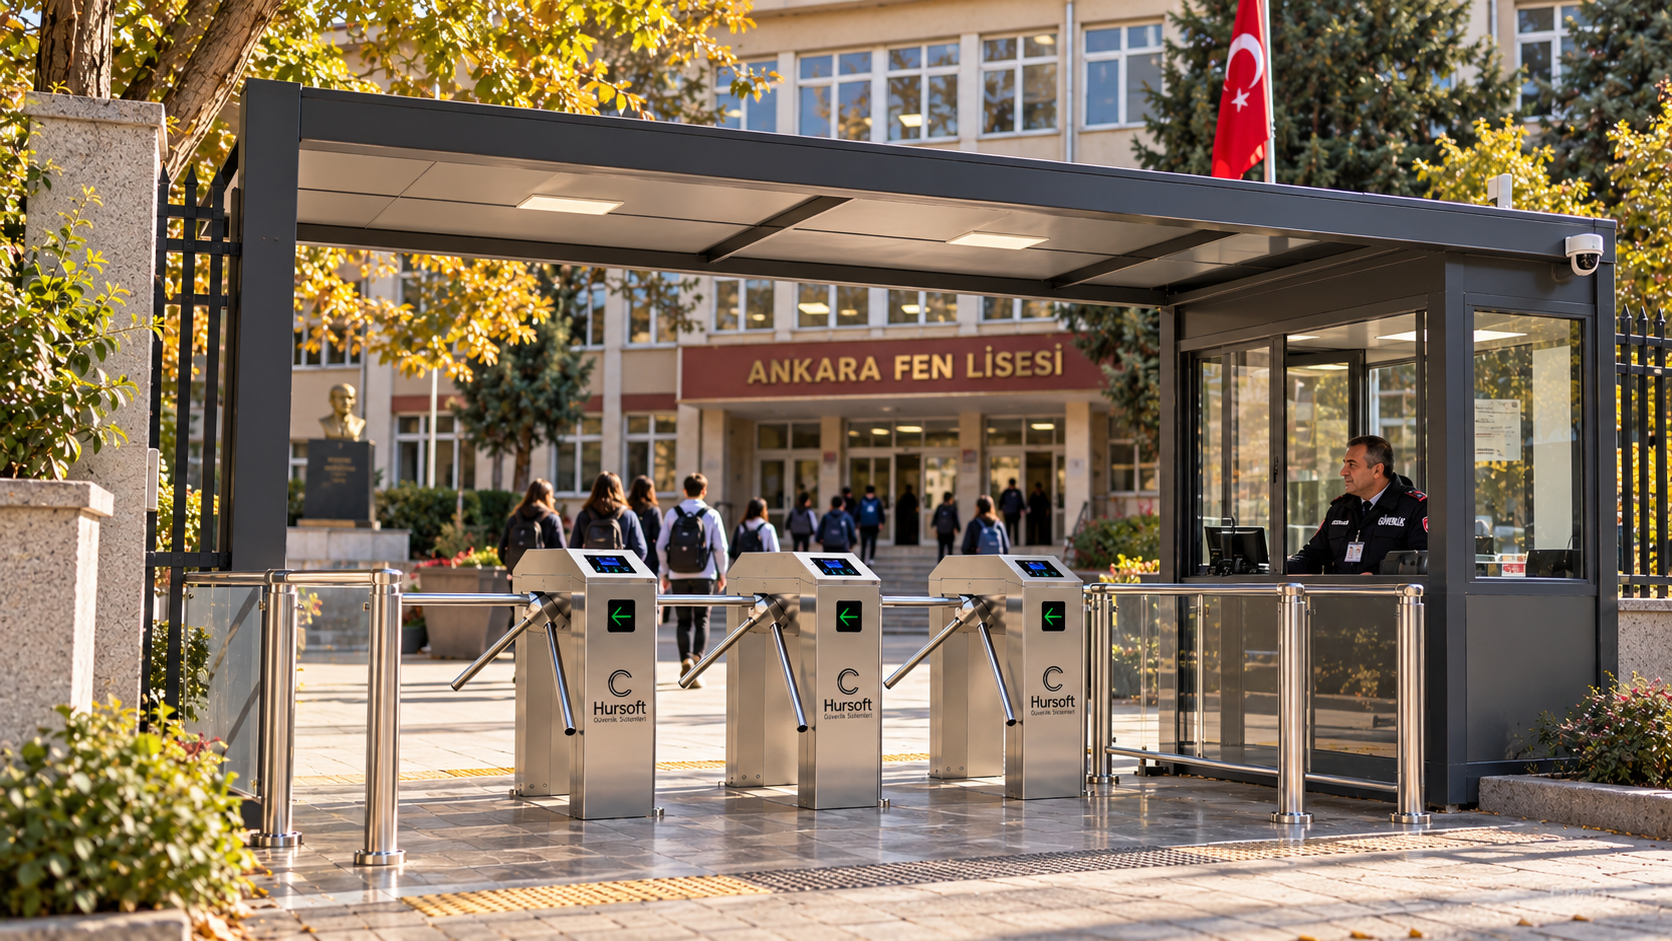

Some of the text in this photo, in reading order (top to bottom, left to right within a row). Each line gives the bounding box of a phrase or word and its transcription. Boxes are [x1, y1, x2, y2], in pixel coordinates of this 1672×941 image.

[747, 343, 1064, 384] ANKARA FEN LİSESİ
[593, 700, 647, 716] Hursoft
[824, 697, 873, 712] Hursoft
[1031, 694, 1076, 709] Hursoft
